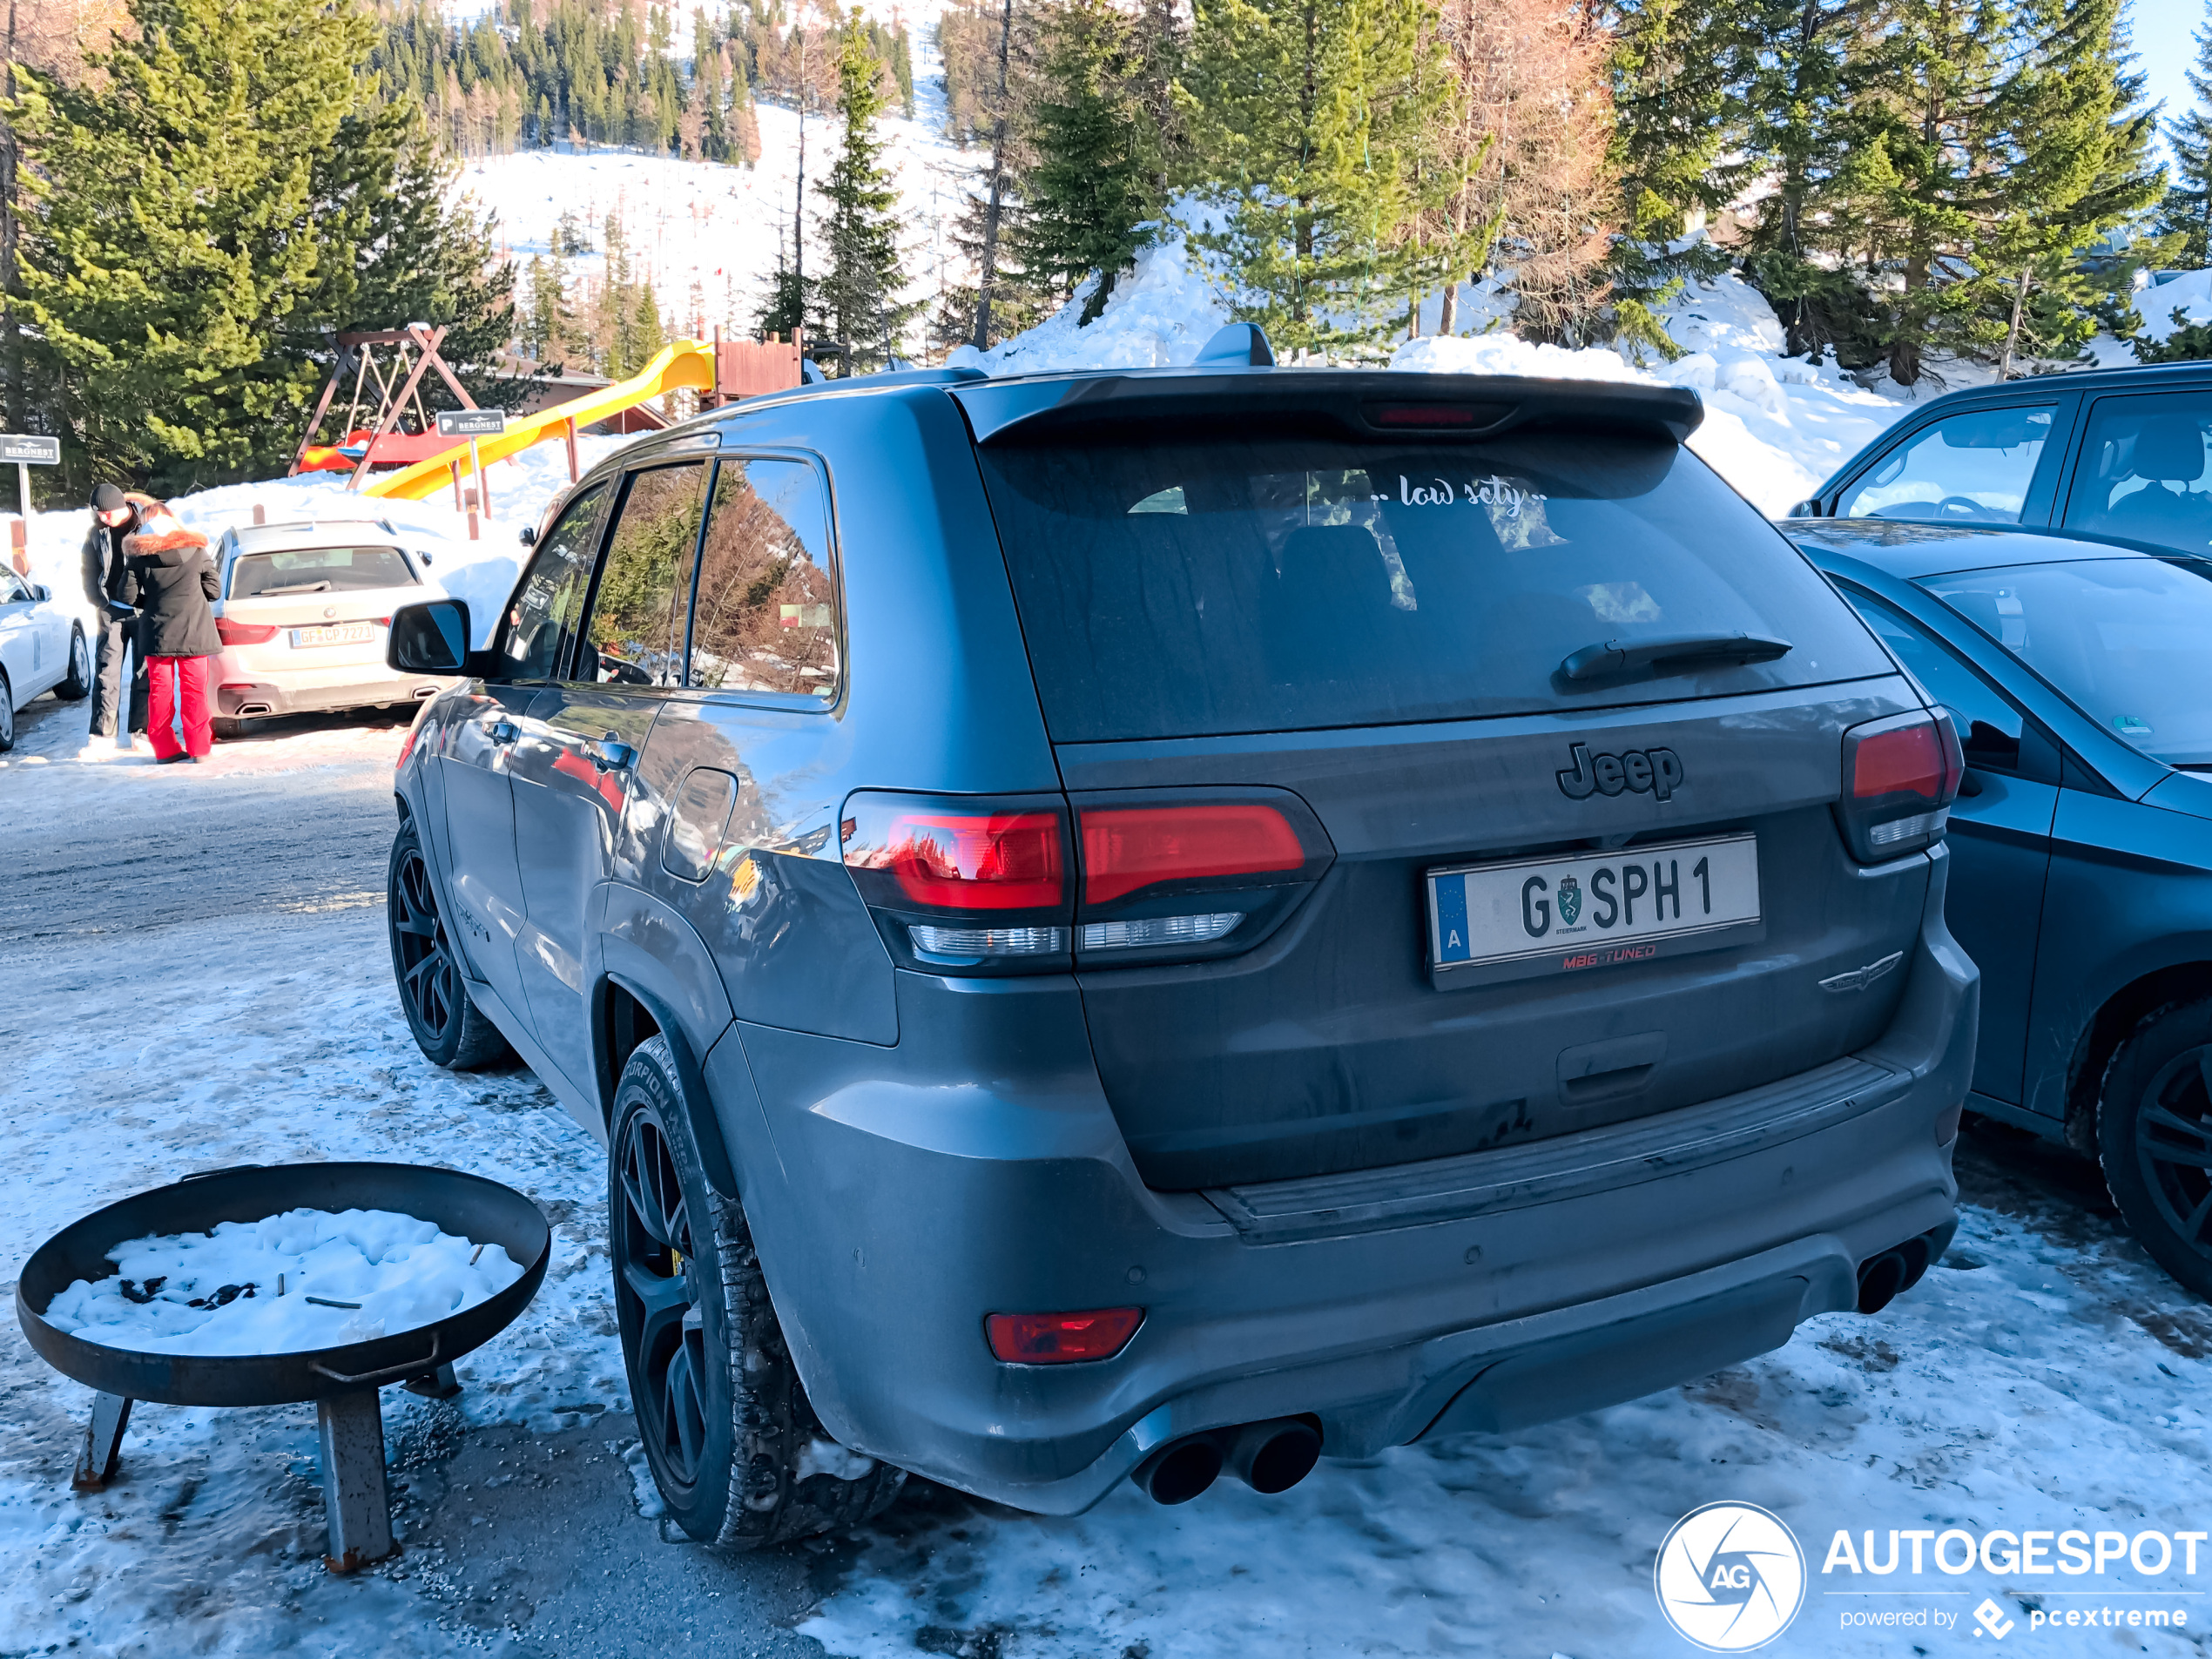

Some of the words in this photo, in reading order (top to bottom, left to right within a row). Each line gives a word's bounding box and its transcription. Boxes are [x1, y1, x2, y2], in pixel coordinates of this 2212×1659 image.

[442, 419, 453, 431] P
[458, 421, 502, 429] BERGNEST
[4, 447, 54, 456] BERGNEST
[1399, 475, 1454, 506] low
[300, 631, 316, 643] GF
[325, 629, 341, 641] CP
[343, 626, 372, 639] 7271
[1555, 742, 1683, 802] Jeep
[1521, 875, 1550, 938] G
[1590, 859, 1681, 928] SPH
[1693, 856, 1711, 914] 1
[1447, 929, 1461, 948] A
[1555, 926, 1588, 935] STEIERMARK
[619, 1061, 670, 1109] SCORPION
